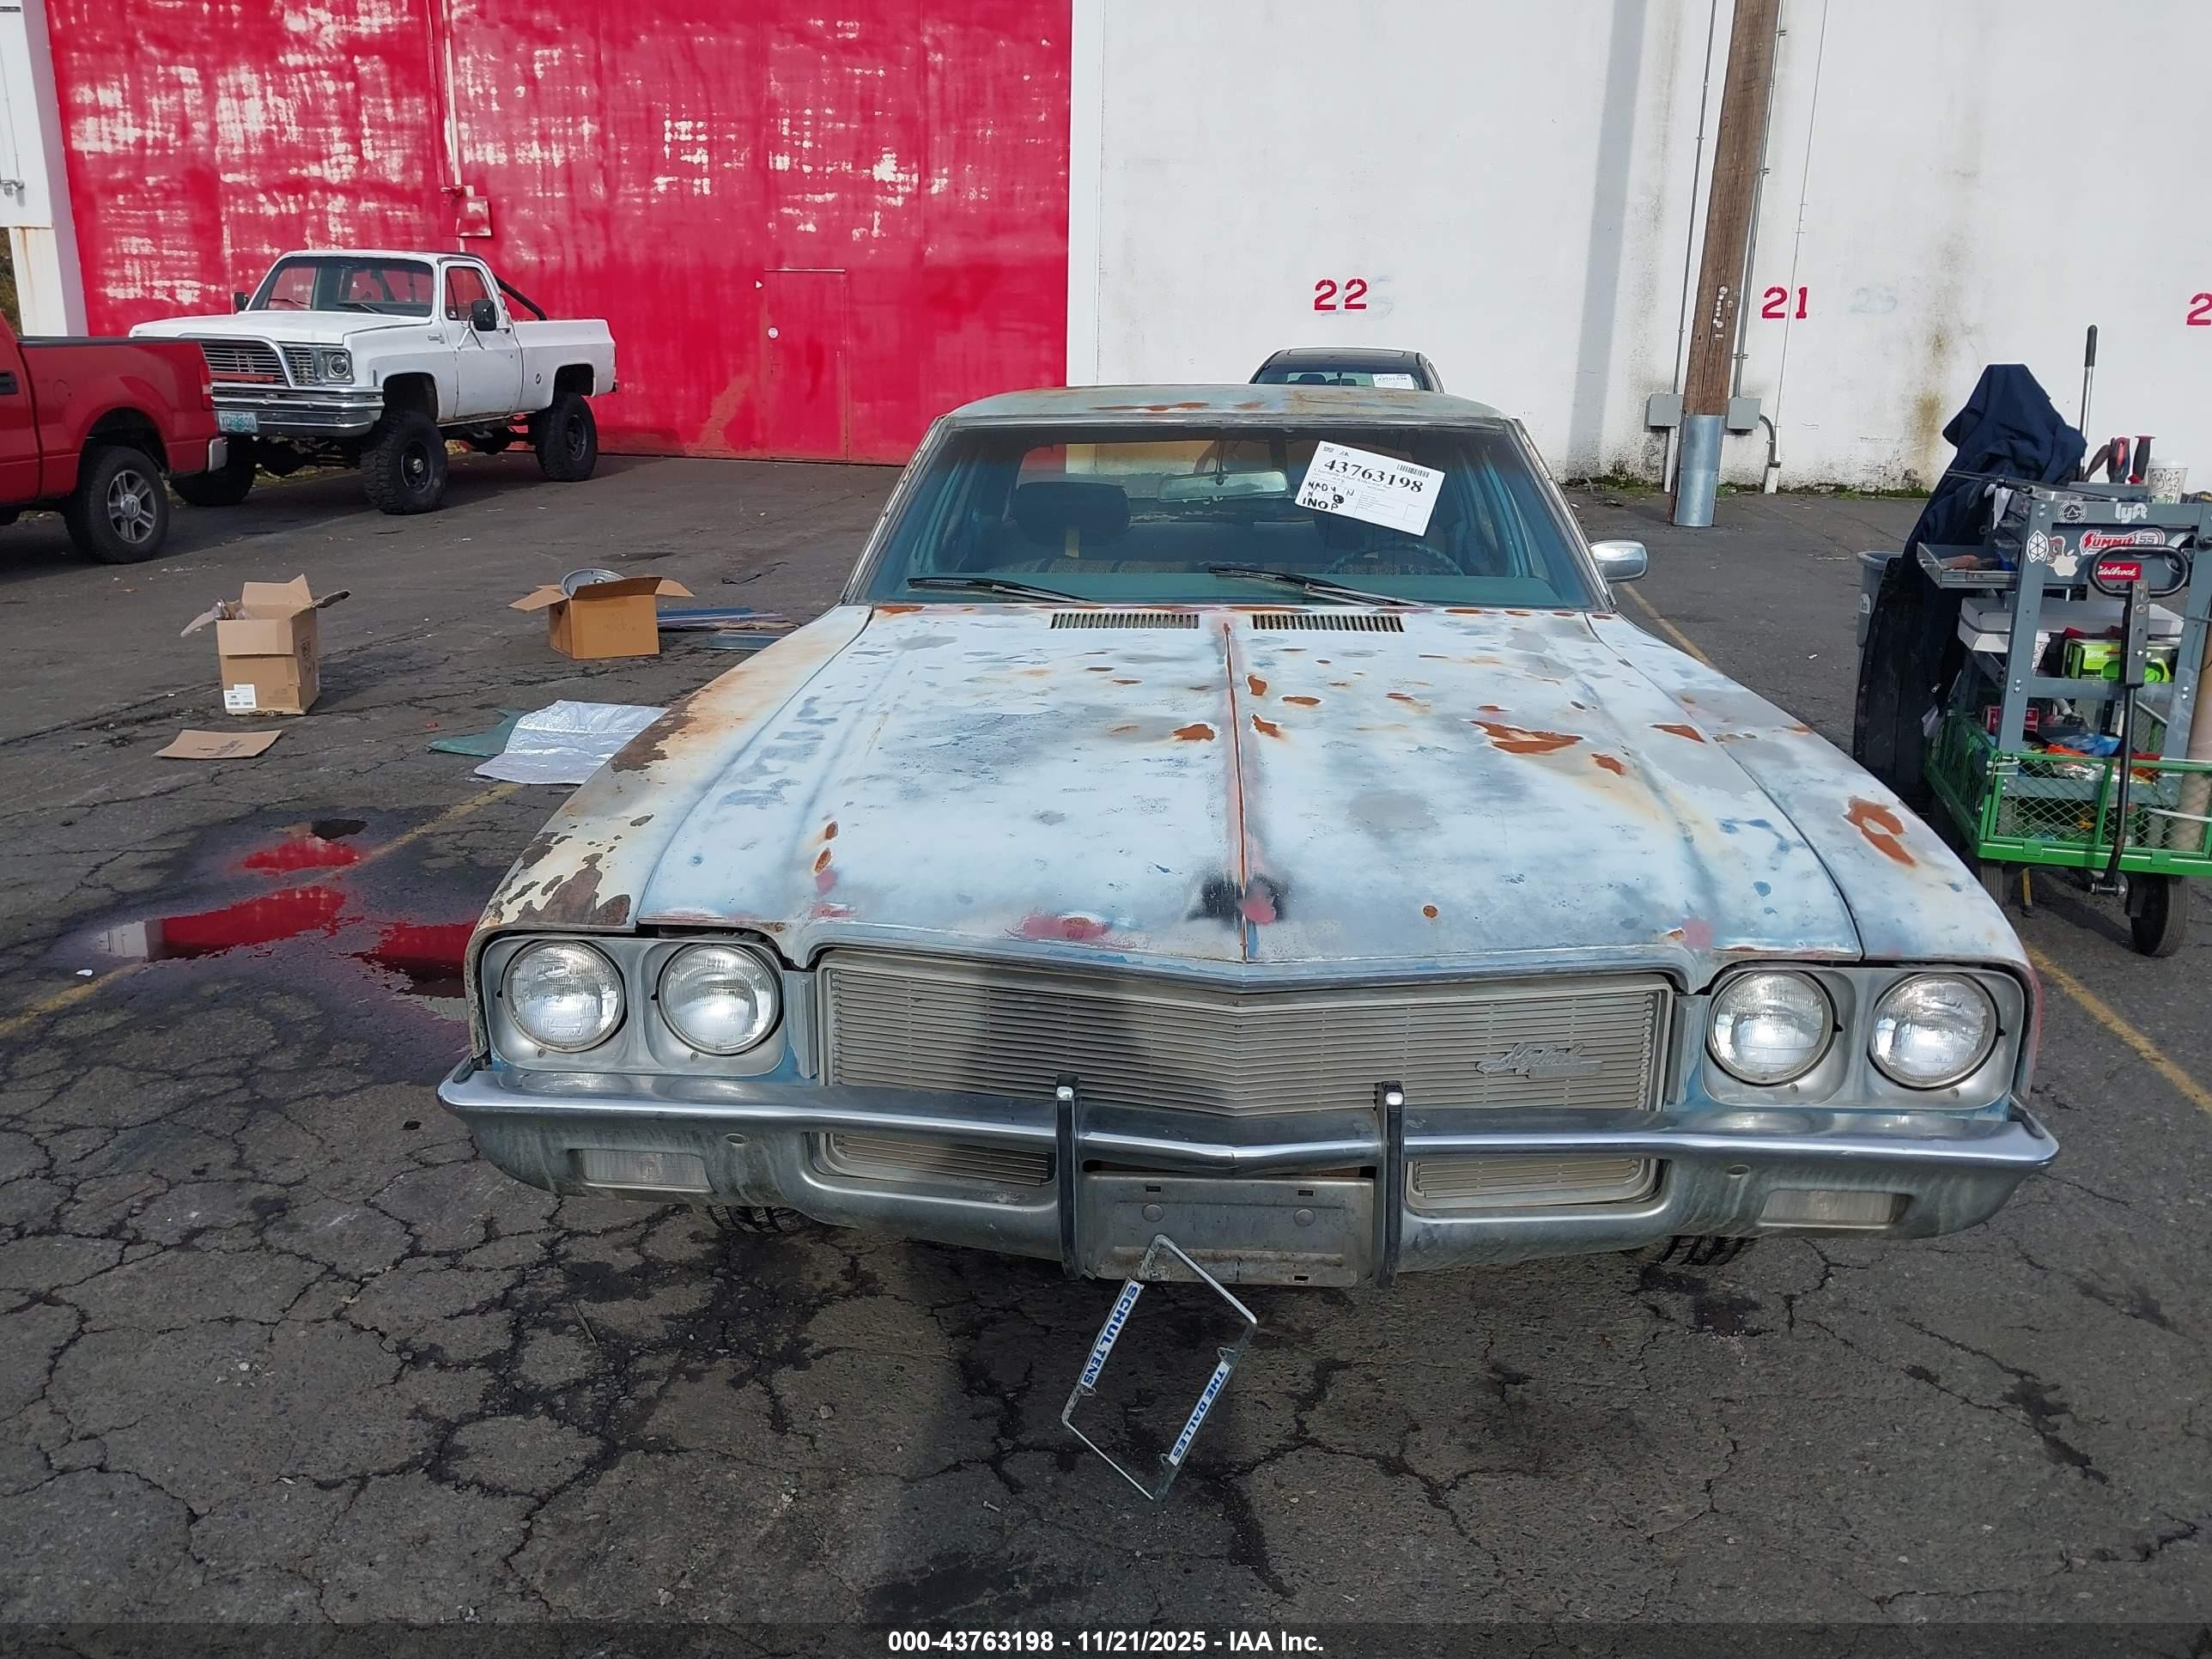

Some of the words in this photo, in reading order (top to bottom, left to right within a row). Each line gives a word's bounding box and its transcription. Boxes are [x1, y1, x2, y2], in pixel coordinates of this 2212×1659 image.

[1314, 279, 1367, 310] 22
[1762, 287, 1808, 319] 21
[1323, 459, 1424, 493] 43763198
[2115, 502, 2148, 524] lyft
[1205, 1371, 1225, 1400] THE
[1173, 1401, 1208, 1458] DALLES
